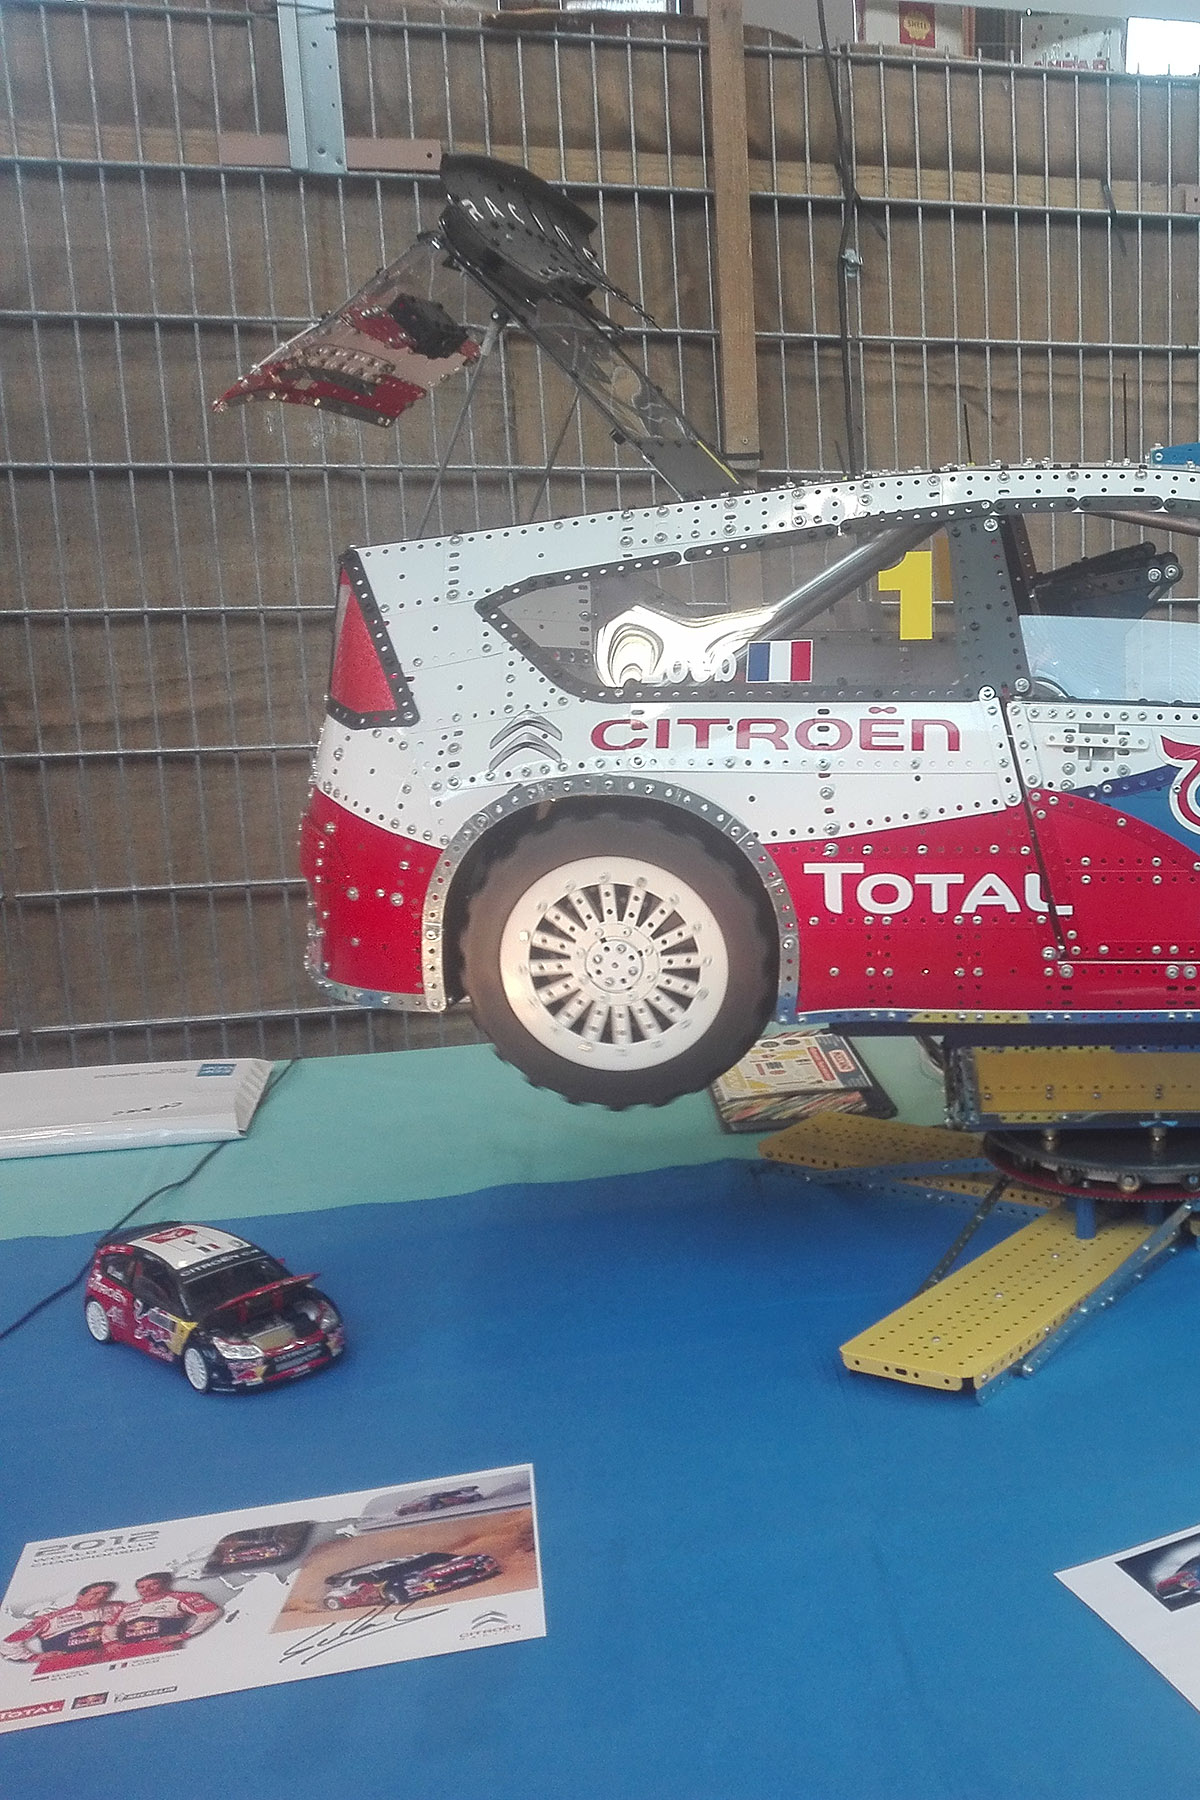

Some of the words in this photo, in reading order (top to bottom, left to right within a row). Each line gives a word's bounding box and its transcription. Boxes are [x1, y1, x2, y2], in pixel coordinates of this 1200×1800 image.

[878, 551, 933, 640] 1
[590, 707, 960, 752] CITROËN
[803, 862, 1073, 916] TOTAL
[34, 1530, 160, 1557] 2012
